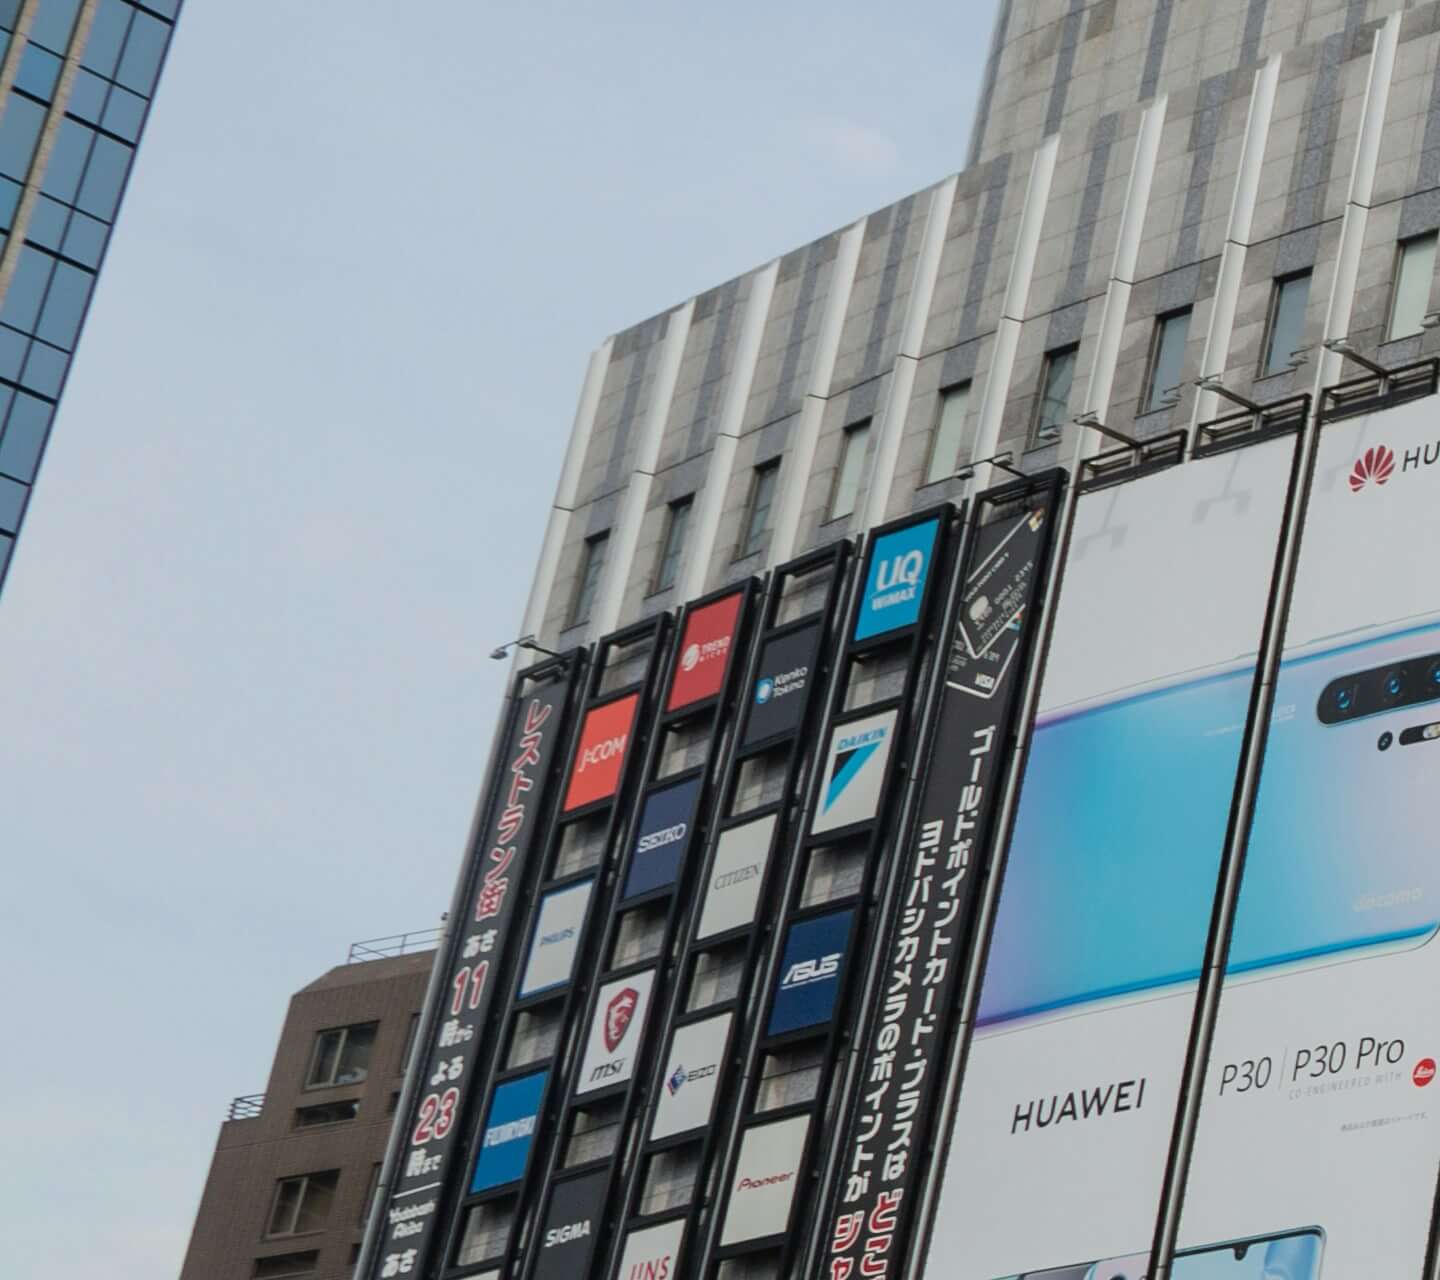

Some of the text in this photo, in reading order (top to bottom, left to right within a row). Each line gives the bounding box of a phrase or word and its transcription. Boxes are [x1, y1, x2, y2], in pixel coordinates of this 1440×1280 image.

[876, 550, 924, 591] UQ
[475, 698, 552, 922] レストラン街
[636, 822, 687, 853] SEIKO
[783, 953, 844, 985] ASUS
[1219, 1036, 1405, 1097] P30 P30 Pro
[1011, 1077, 1147, 1136] HUAWEI
[544, 1220, 591, 1248] SIGMA
